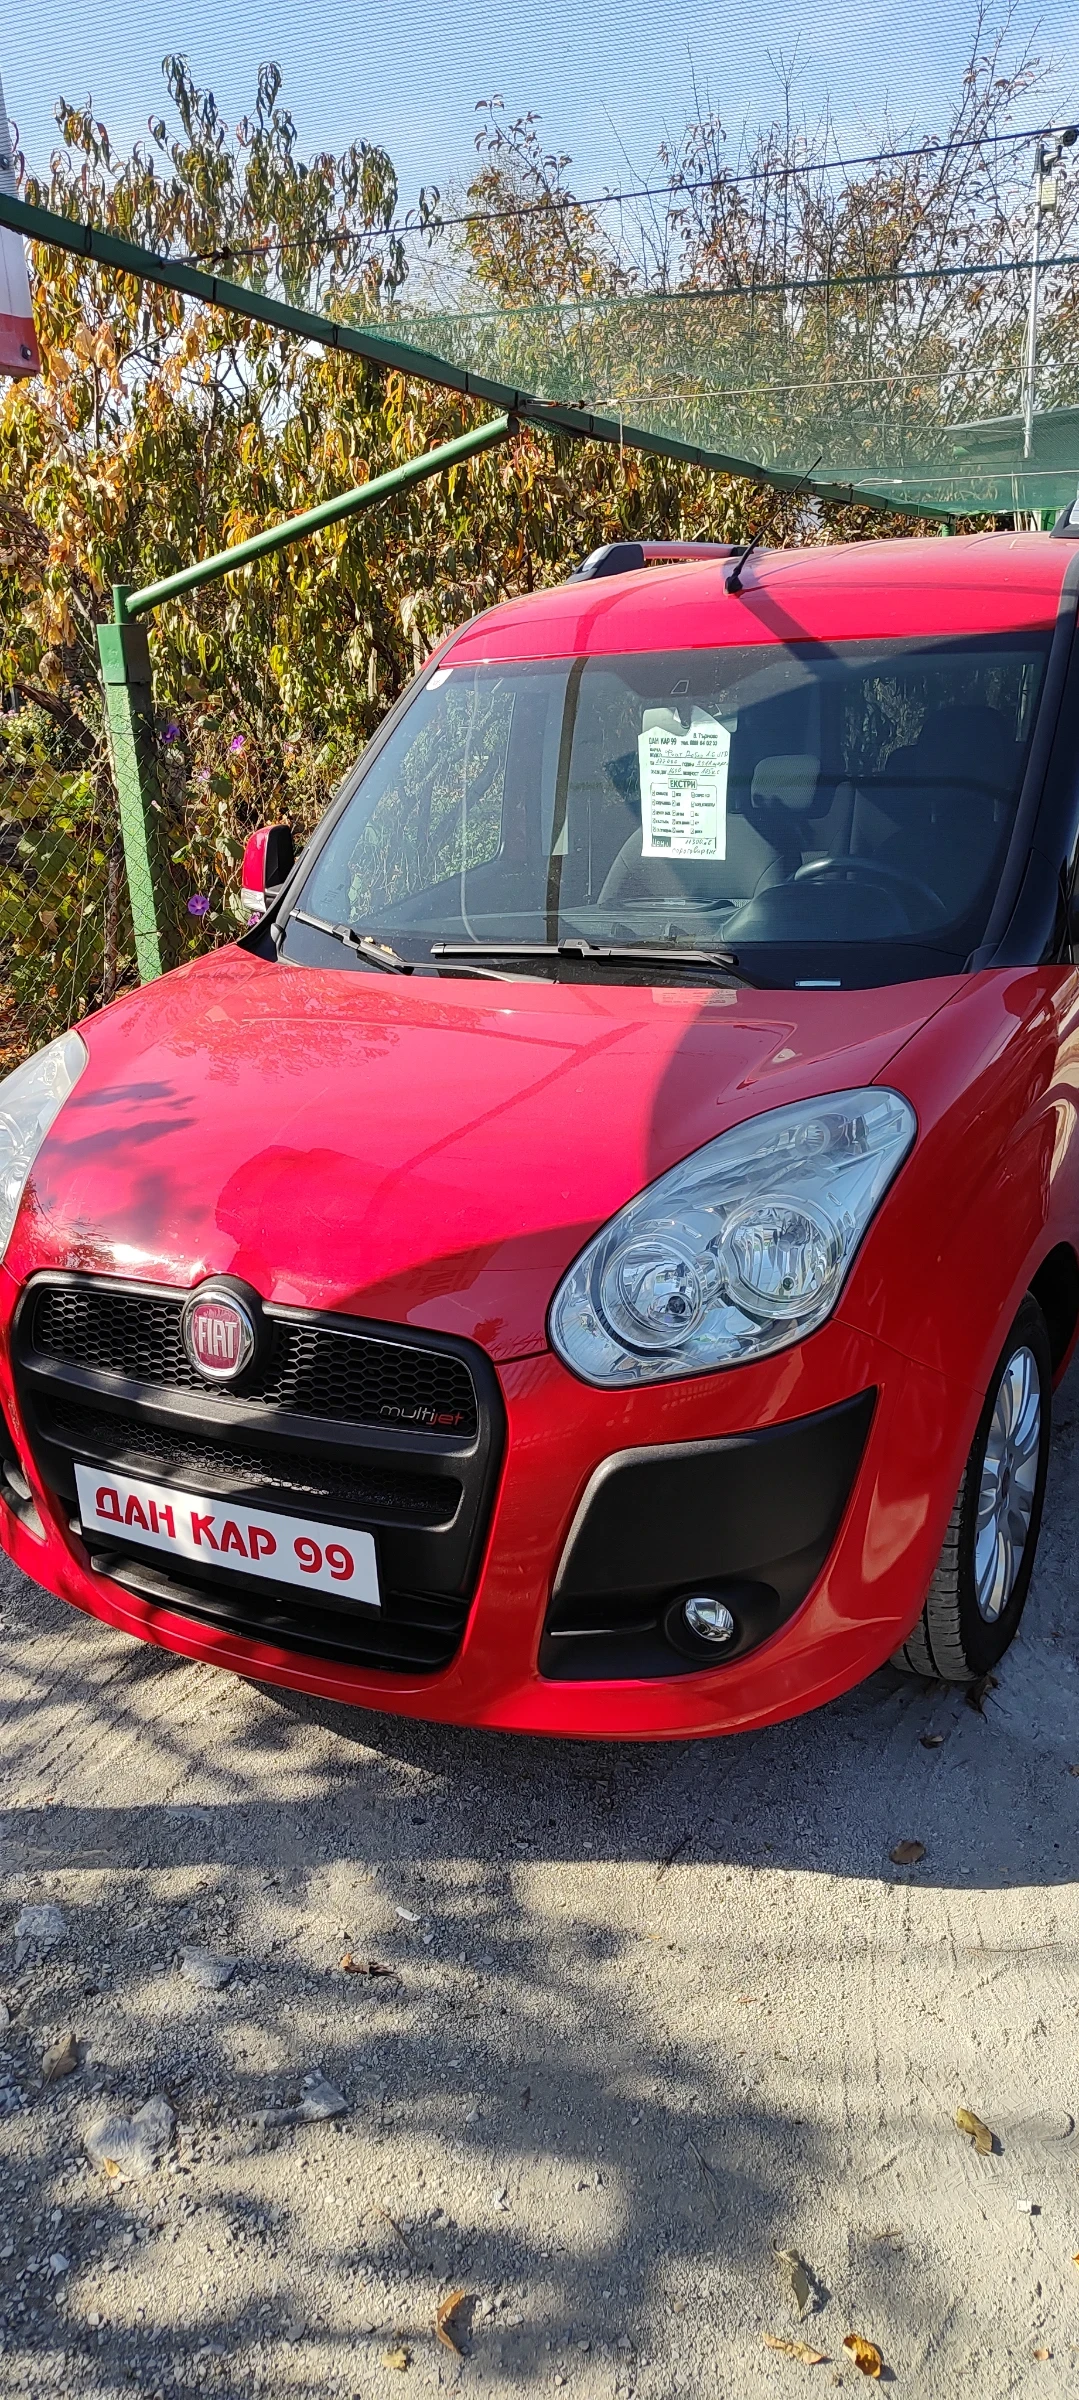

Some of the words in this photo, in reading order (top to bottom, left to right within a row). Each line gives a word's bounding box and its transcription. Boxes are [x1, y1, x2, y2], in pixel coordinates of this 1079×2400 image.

[660, 737, 670, 745] КАР
[671, 737, 677, 745] 99
[670, 780, 695, 788] ЕКСТРИ
[198, 1315, 238, 1359] FIAT
[379, 1405, 464, 1426] multijet
[95, 1486, 176, 1539] ДАН
[190, 1511, 277, 1561] КАР
[293, 1536, 355, 1581] 99
